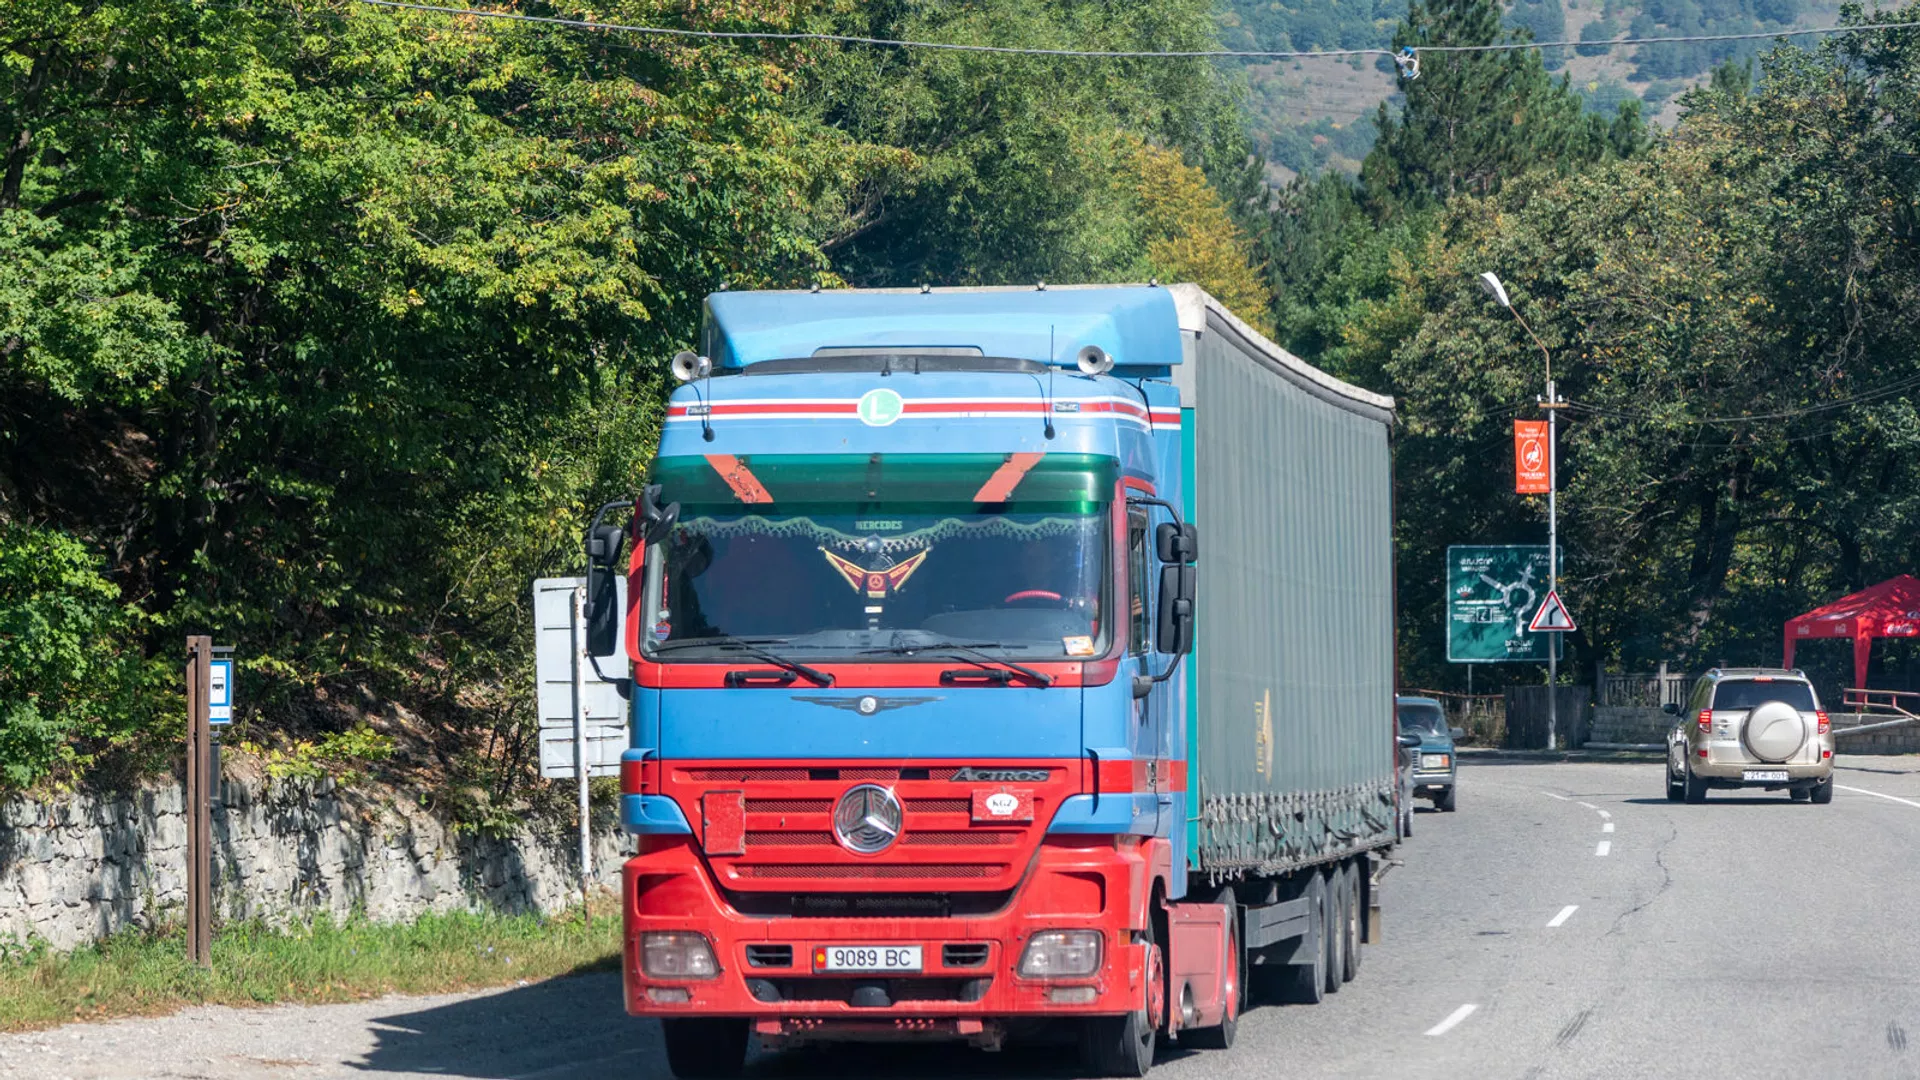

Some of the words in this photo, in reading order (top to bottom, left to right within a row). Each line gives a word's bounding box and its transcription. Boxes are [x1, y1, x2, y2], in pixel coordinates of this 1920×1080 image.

[869, 395, 890, 420] L
[834, 949, 878, 967] 9089
[885, 949, 911, 967] BC
